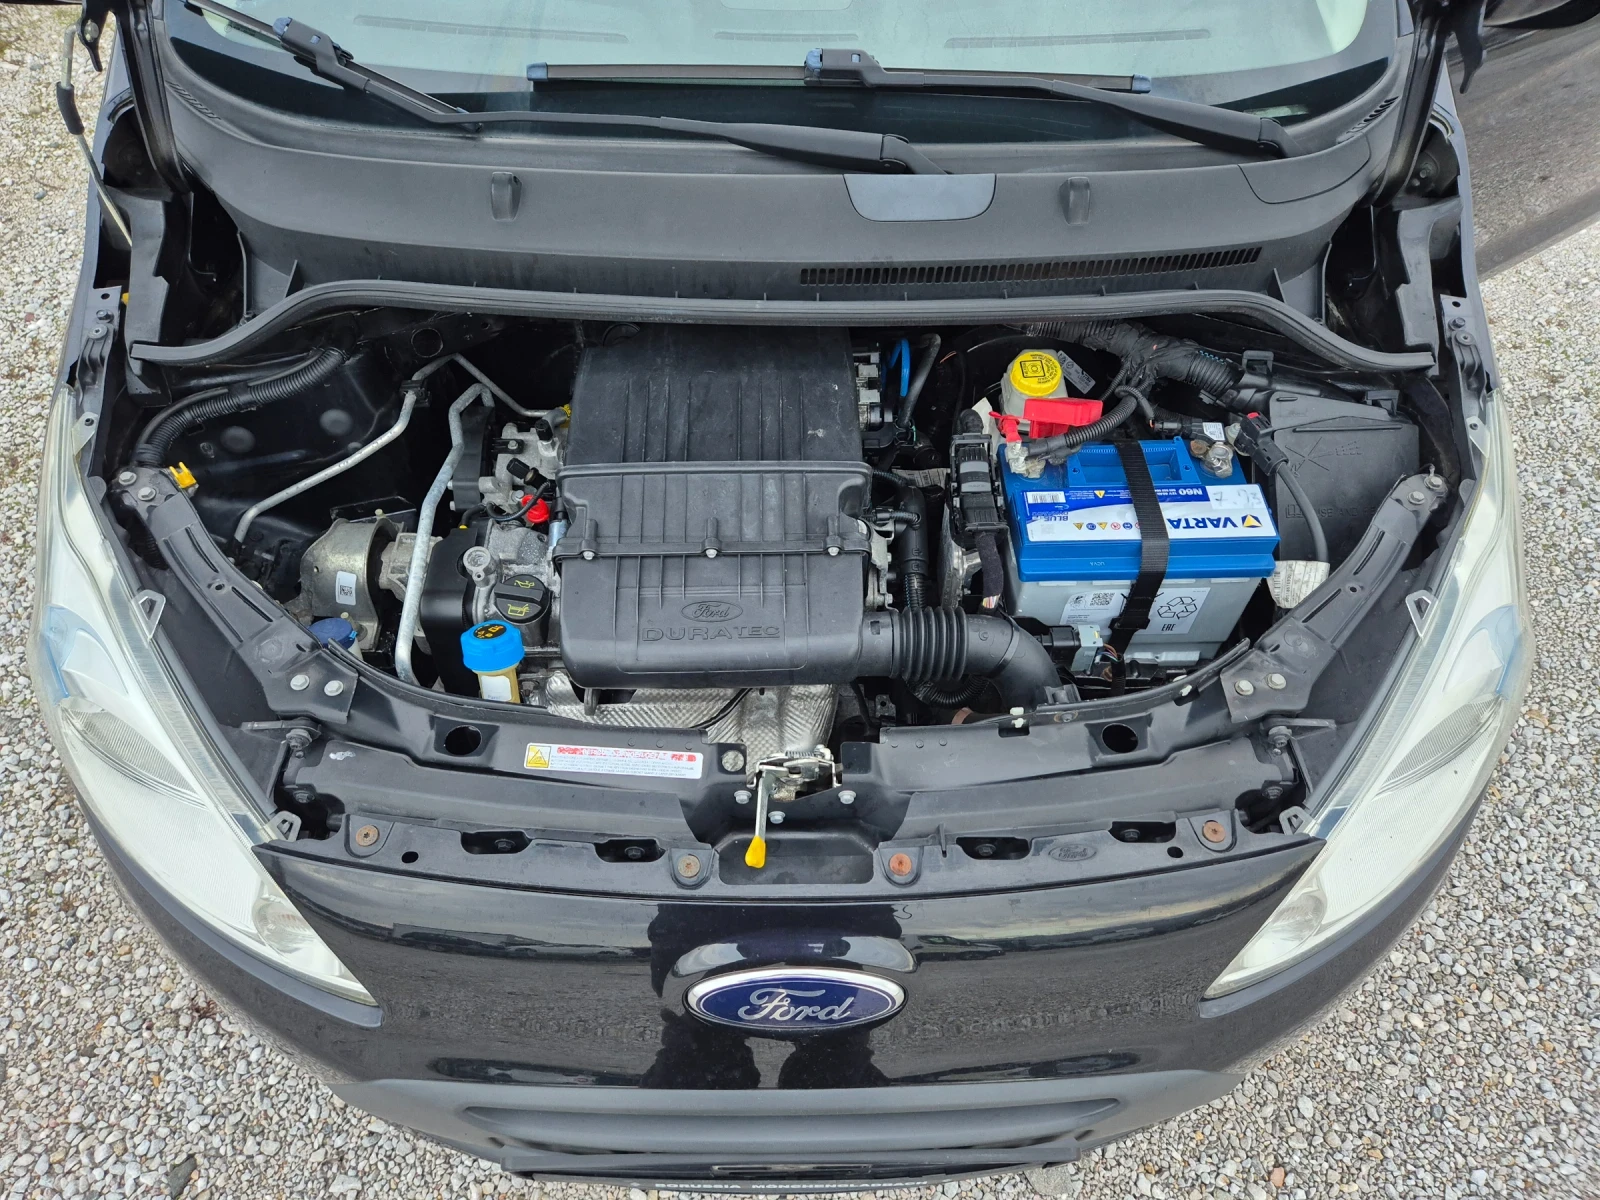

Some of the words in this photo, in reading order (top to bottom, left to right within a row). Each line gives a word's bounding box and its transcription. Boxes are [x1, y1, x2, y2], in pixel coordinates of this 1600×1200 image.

[1178, 488, 1203, 496] N60
[1166, 516, 1239, 530] VARTA
[691, 603, 731, 619] Ford
[642, 626, 780, 641] DURATEC
[737, 987, 855, 1021] Ford
